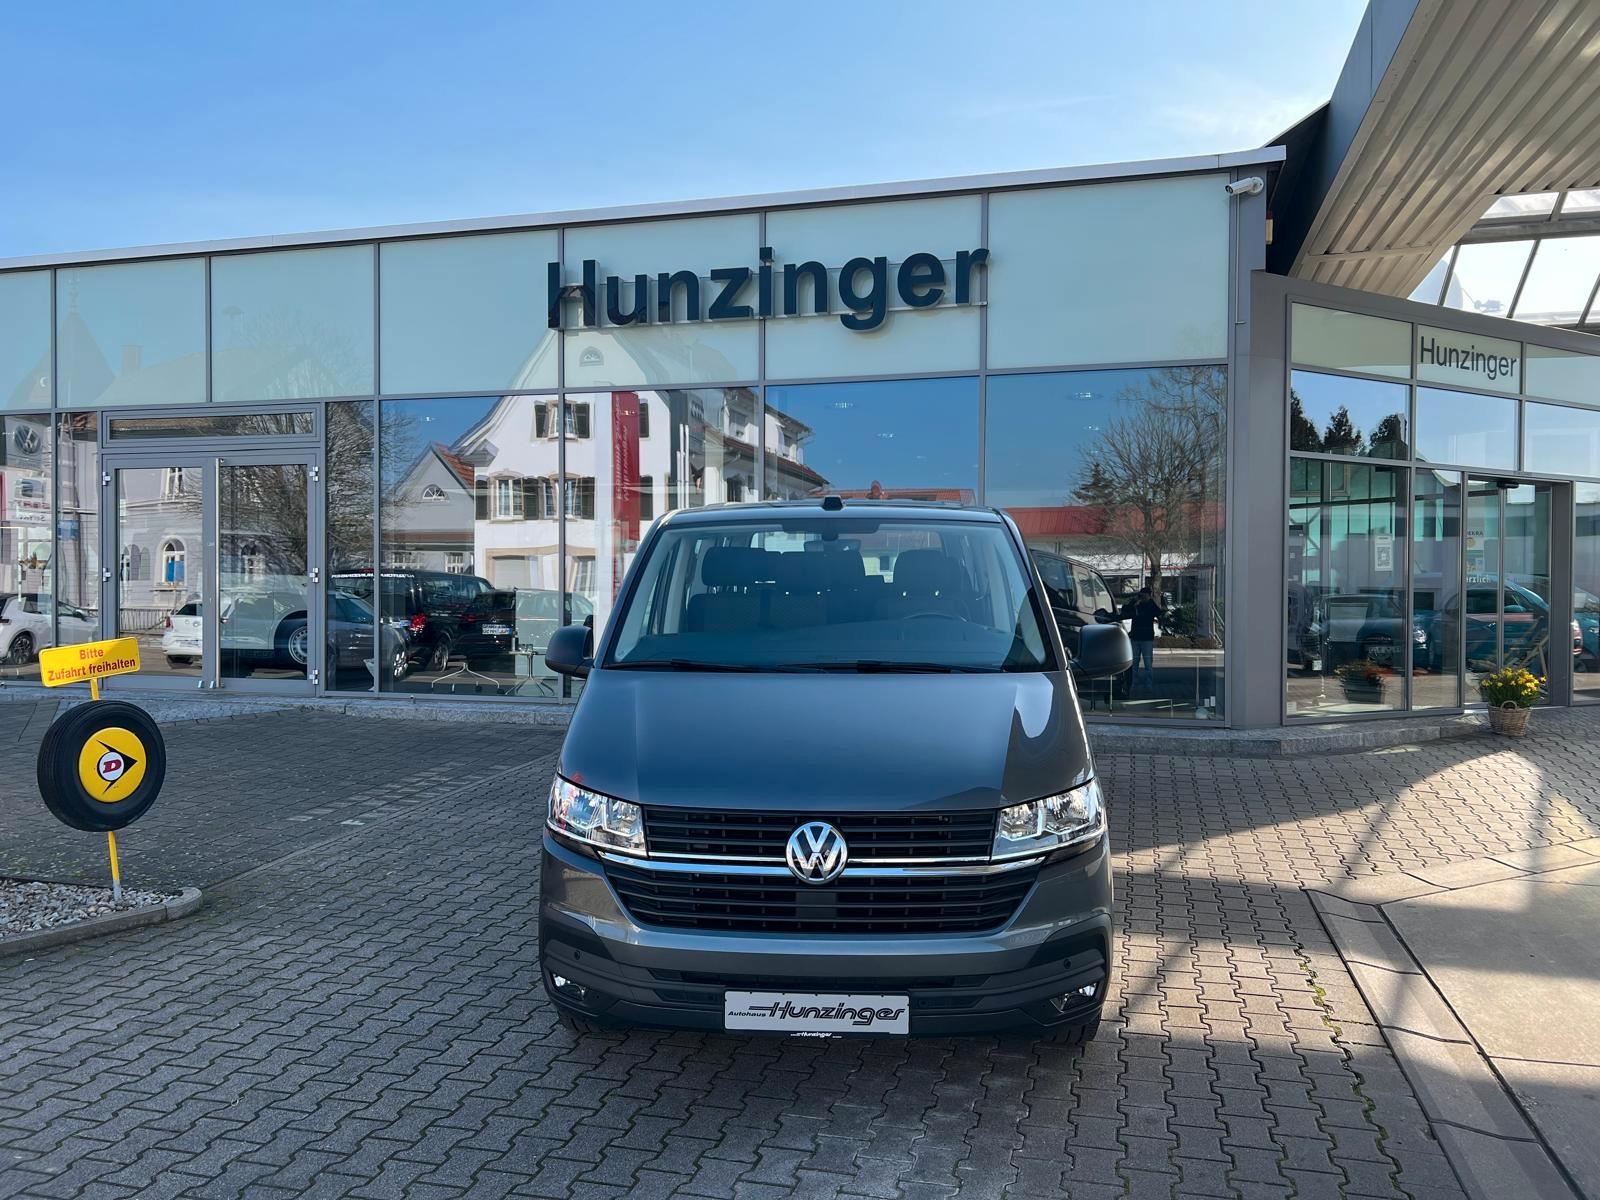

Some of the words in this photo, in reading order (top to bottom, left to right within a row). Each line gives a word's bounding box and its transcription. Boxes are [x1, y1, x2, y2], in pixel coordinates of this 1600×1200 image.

[547, 246, 990, 332] Hunzinger
[1420, 335, 1518, 381] Hunzinger
[79, 648, 104, 660] Bitte
[48, 665, 87, 682] Zufahrt
[88, 658, 136, 675] freihalten
[727, 1010, 767, 1018] Autohaus
[748, 1000, 906, 1026] Hunzinger
